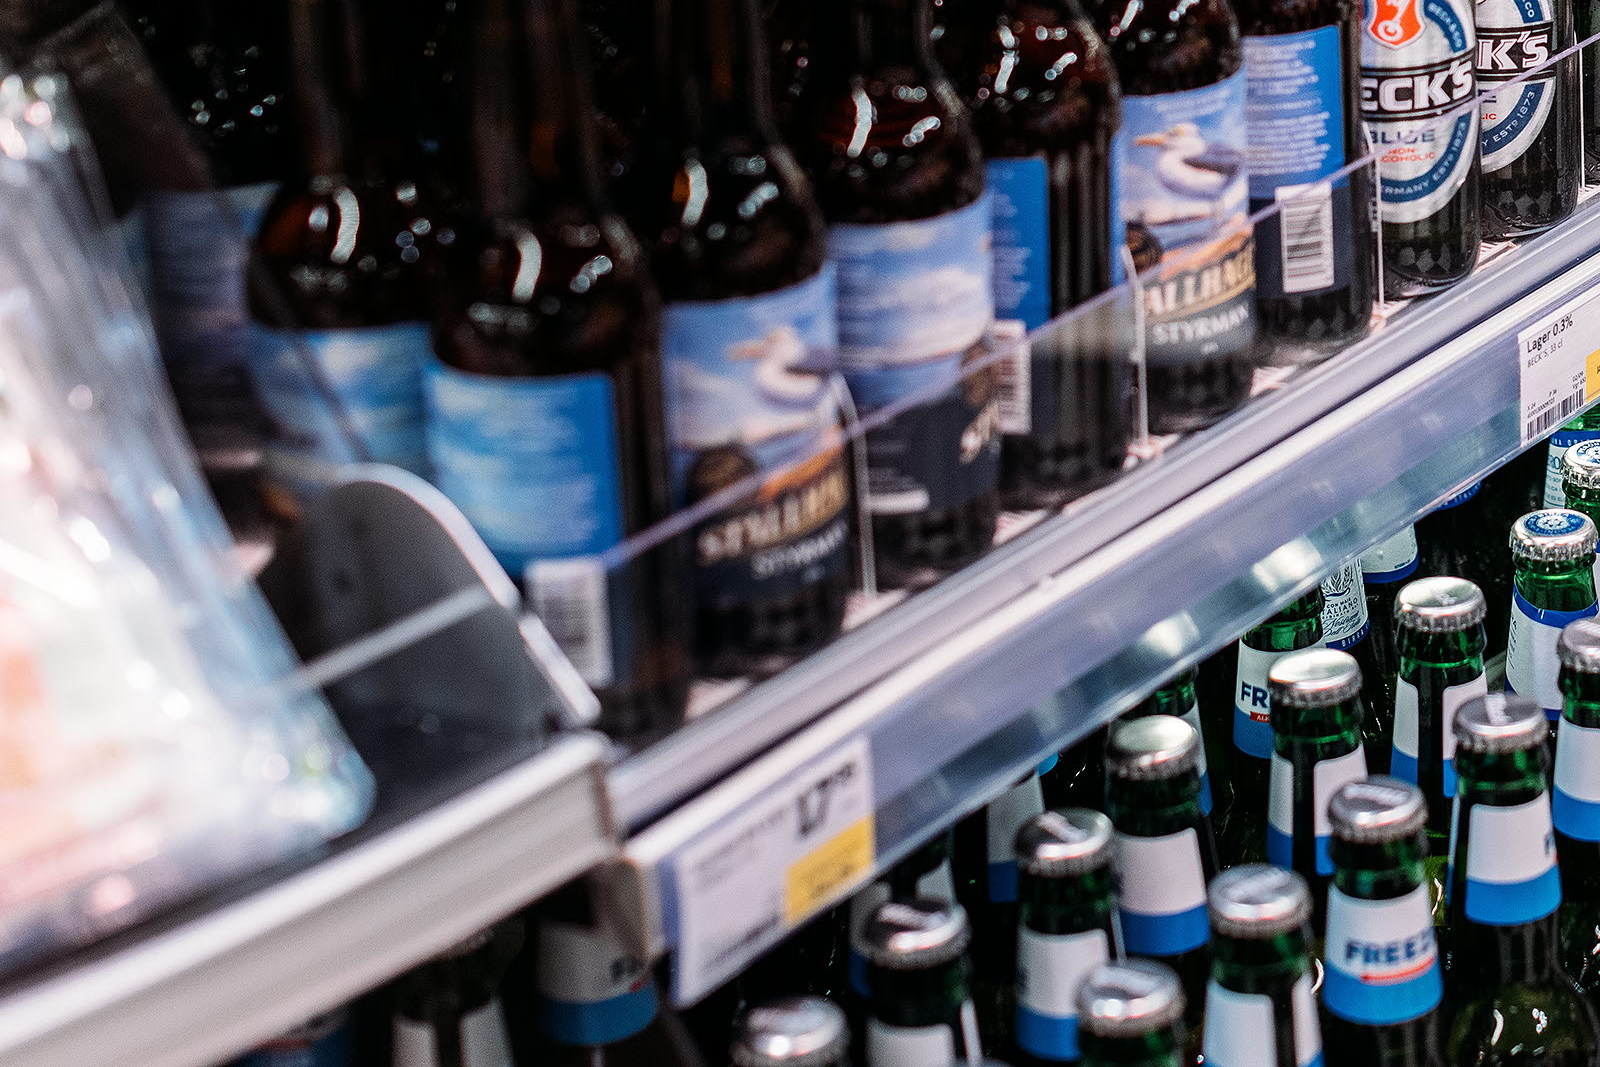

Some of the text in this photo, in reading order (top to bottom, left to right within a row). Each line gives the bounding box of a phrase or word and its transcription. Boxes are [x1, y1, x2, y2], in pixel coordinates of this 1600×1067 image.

[1478, 30, 1549, 71] K'S
[1361, 57, 1474, 113] ECK'S
[1518, 90, 1536, 117] 1873
[1527, 312, 1575, 354] Lager 0.3%
[1549, 342, 1557, 355] 33
[1557, 338, 1563, 351] cl
